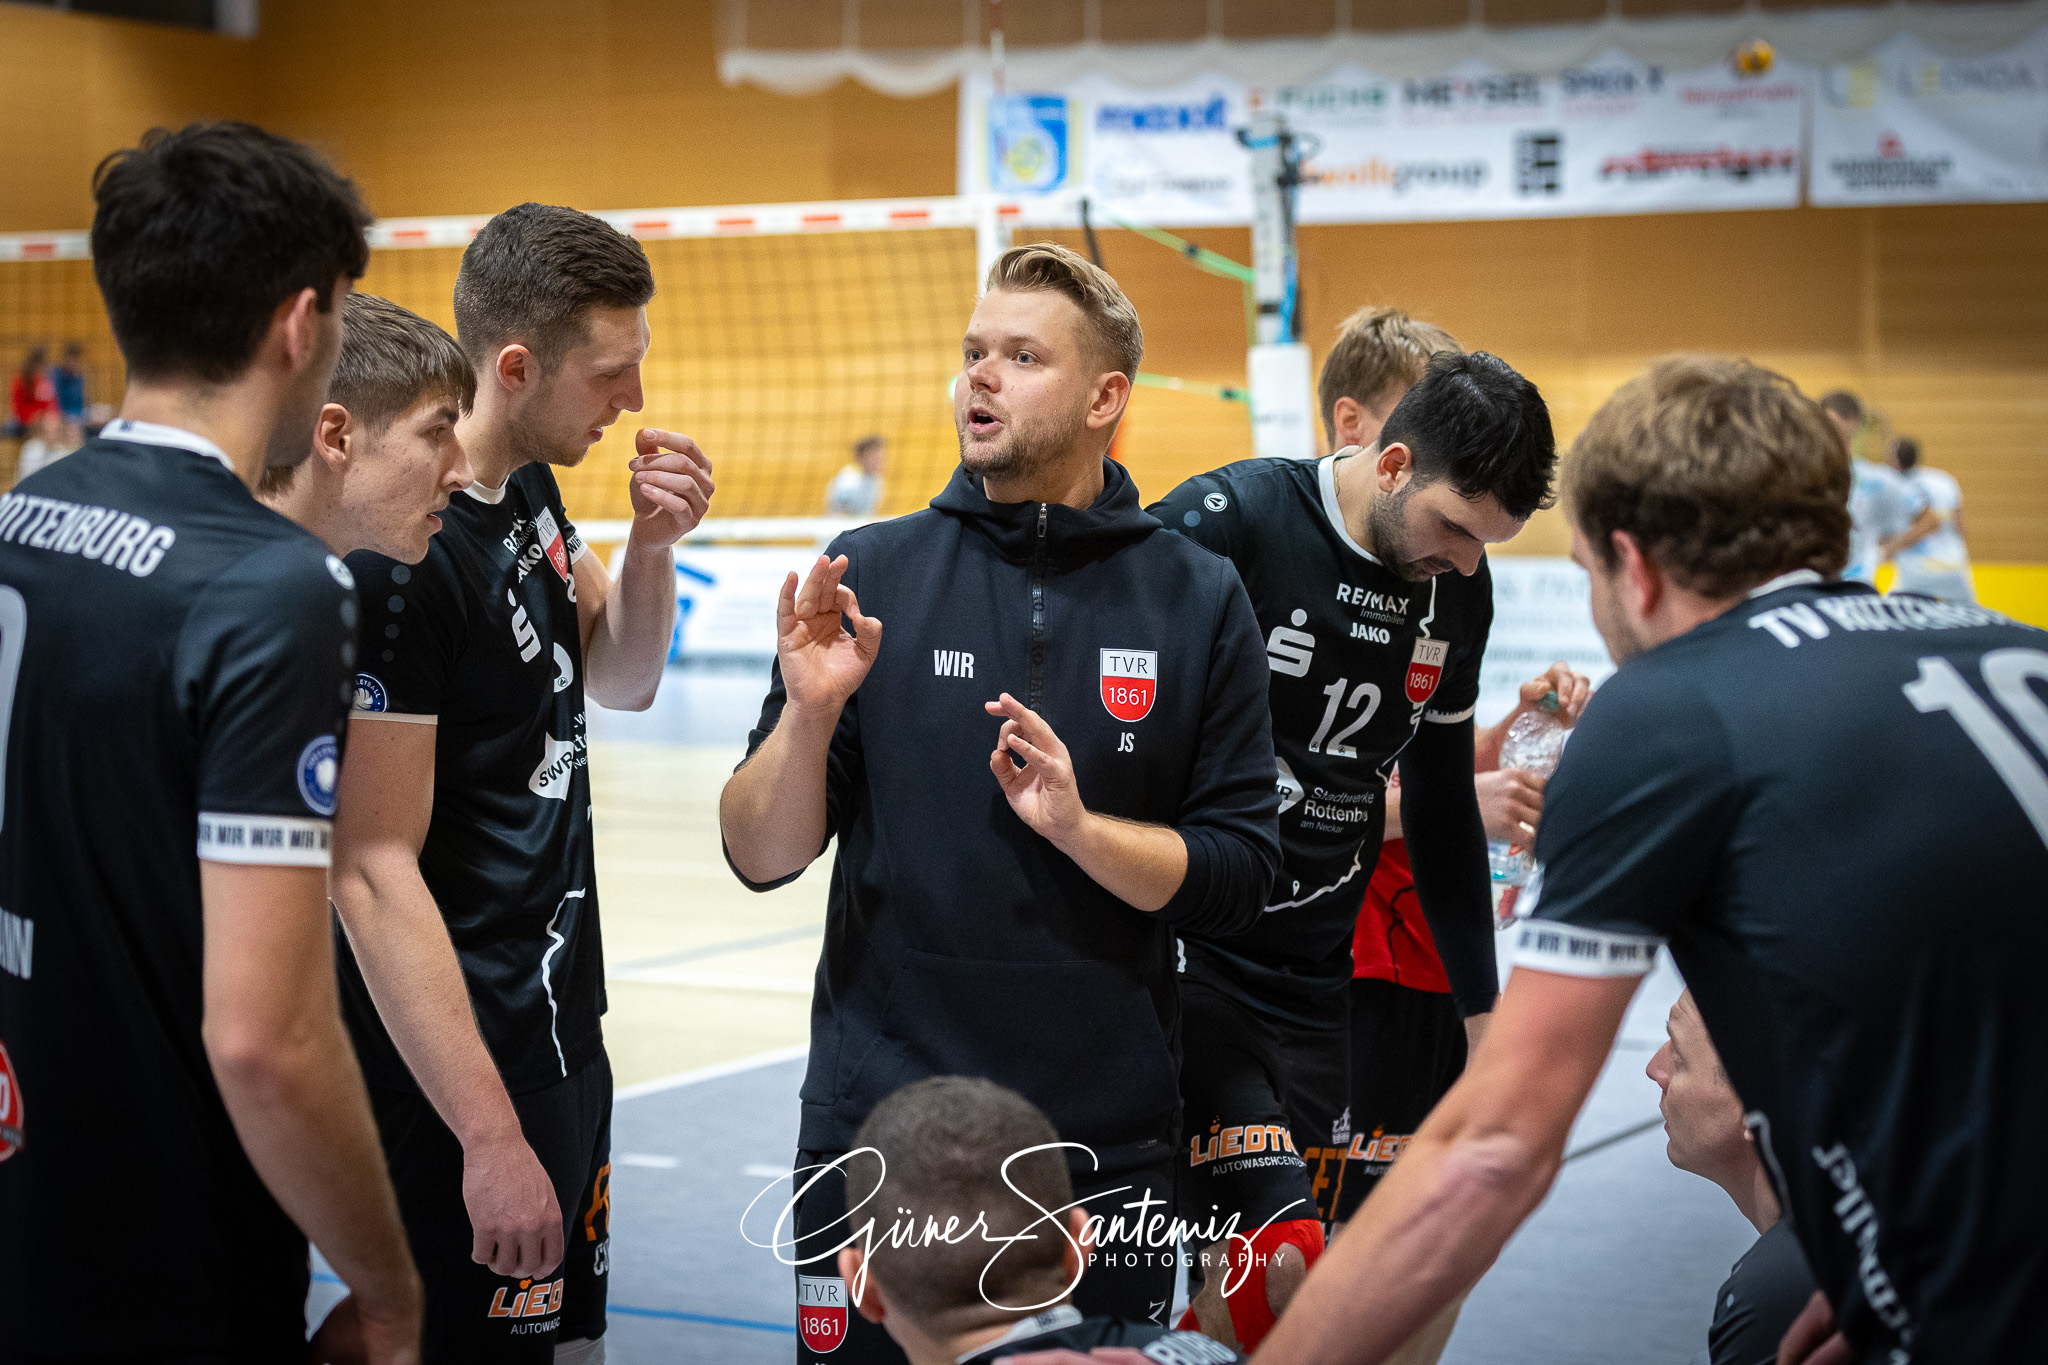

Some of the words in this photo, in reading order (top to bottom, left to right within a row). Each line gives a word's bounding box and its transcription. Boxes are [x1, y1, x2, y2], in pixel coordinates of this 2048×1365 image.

[1350, 622, 1391, 644] JAKO
[1748, 602, 1830, 648] TV
[1418, 644, 1441, 662] TVR
[933, 649, 975, 679] WIR
[1109, 656, 1148, 674] TVR
[1409, 672, 1434, 690] 1861
[1108, 687, 1147, 706] 1861
[1308, 677, 1382, 759] 12
[1117, 732, 1135, 752] JS
[538, 751, 575, 788] SWR
[1300, 820, 1315, 830] am
[802, 1283, 839, 1302] TVR
[803, 1316, 839, 1336] 1861
